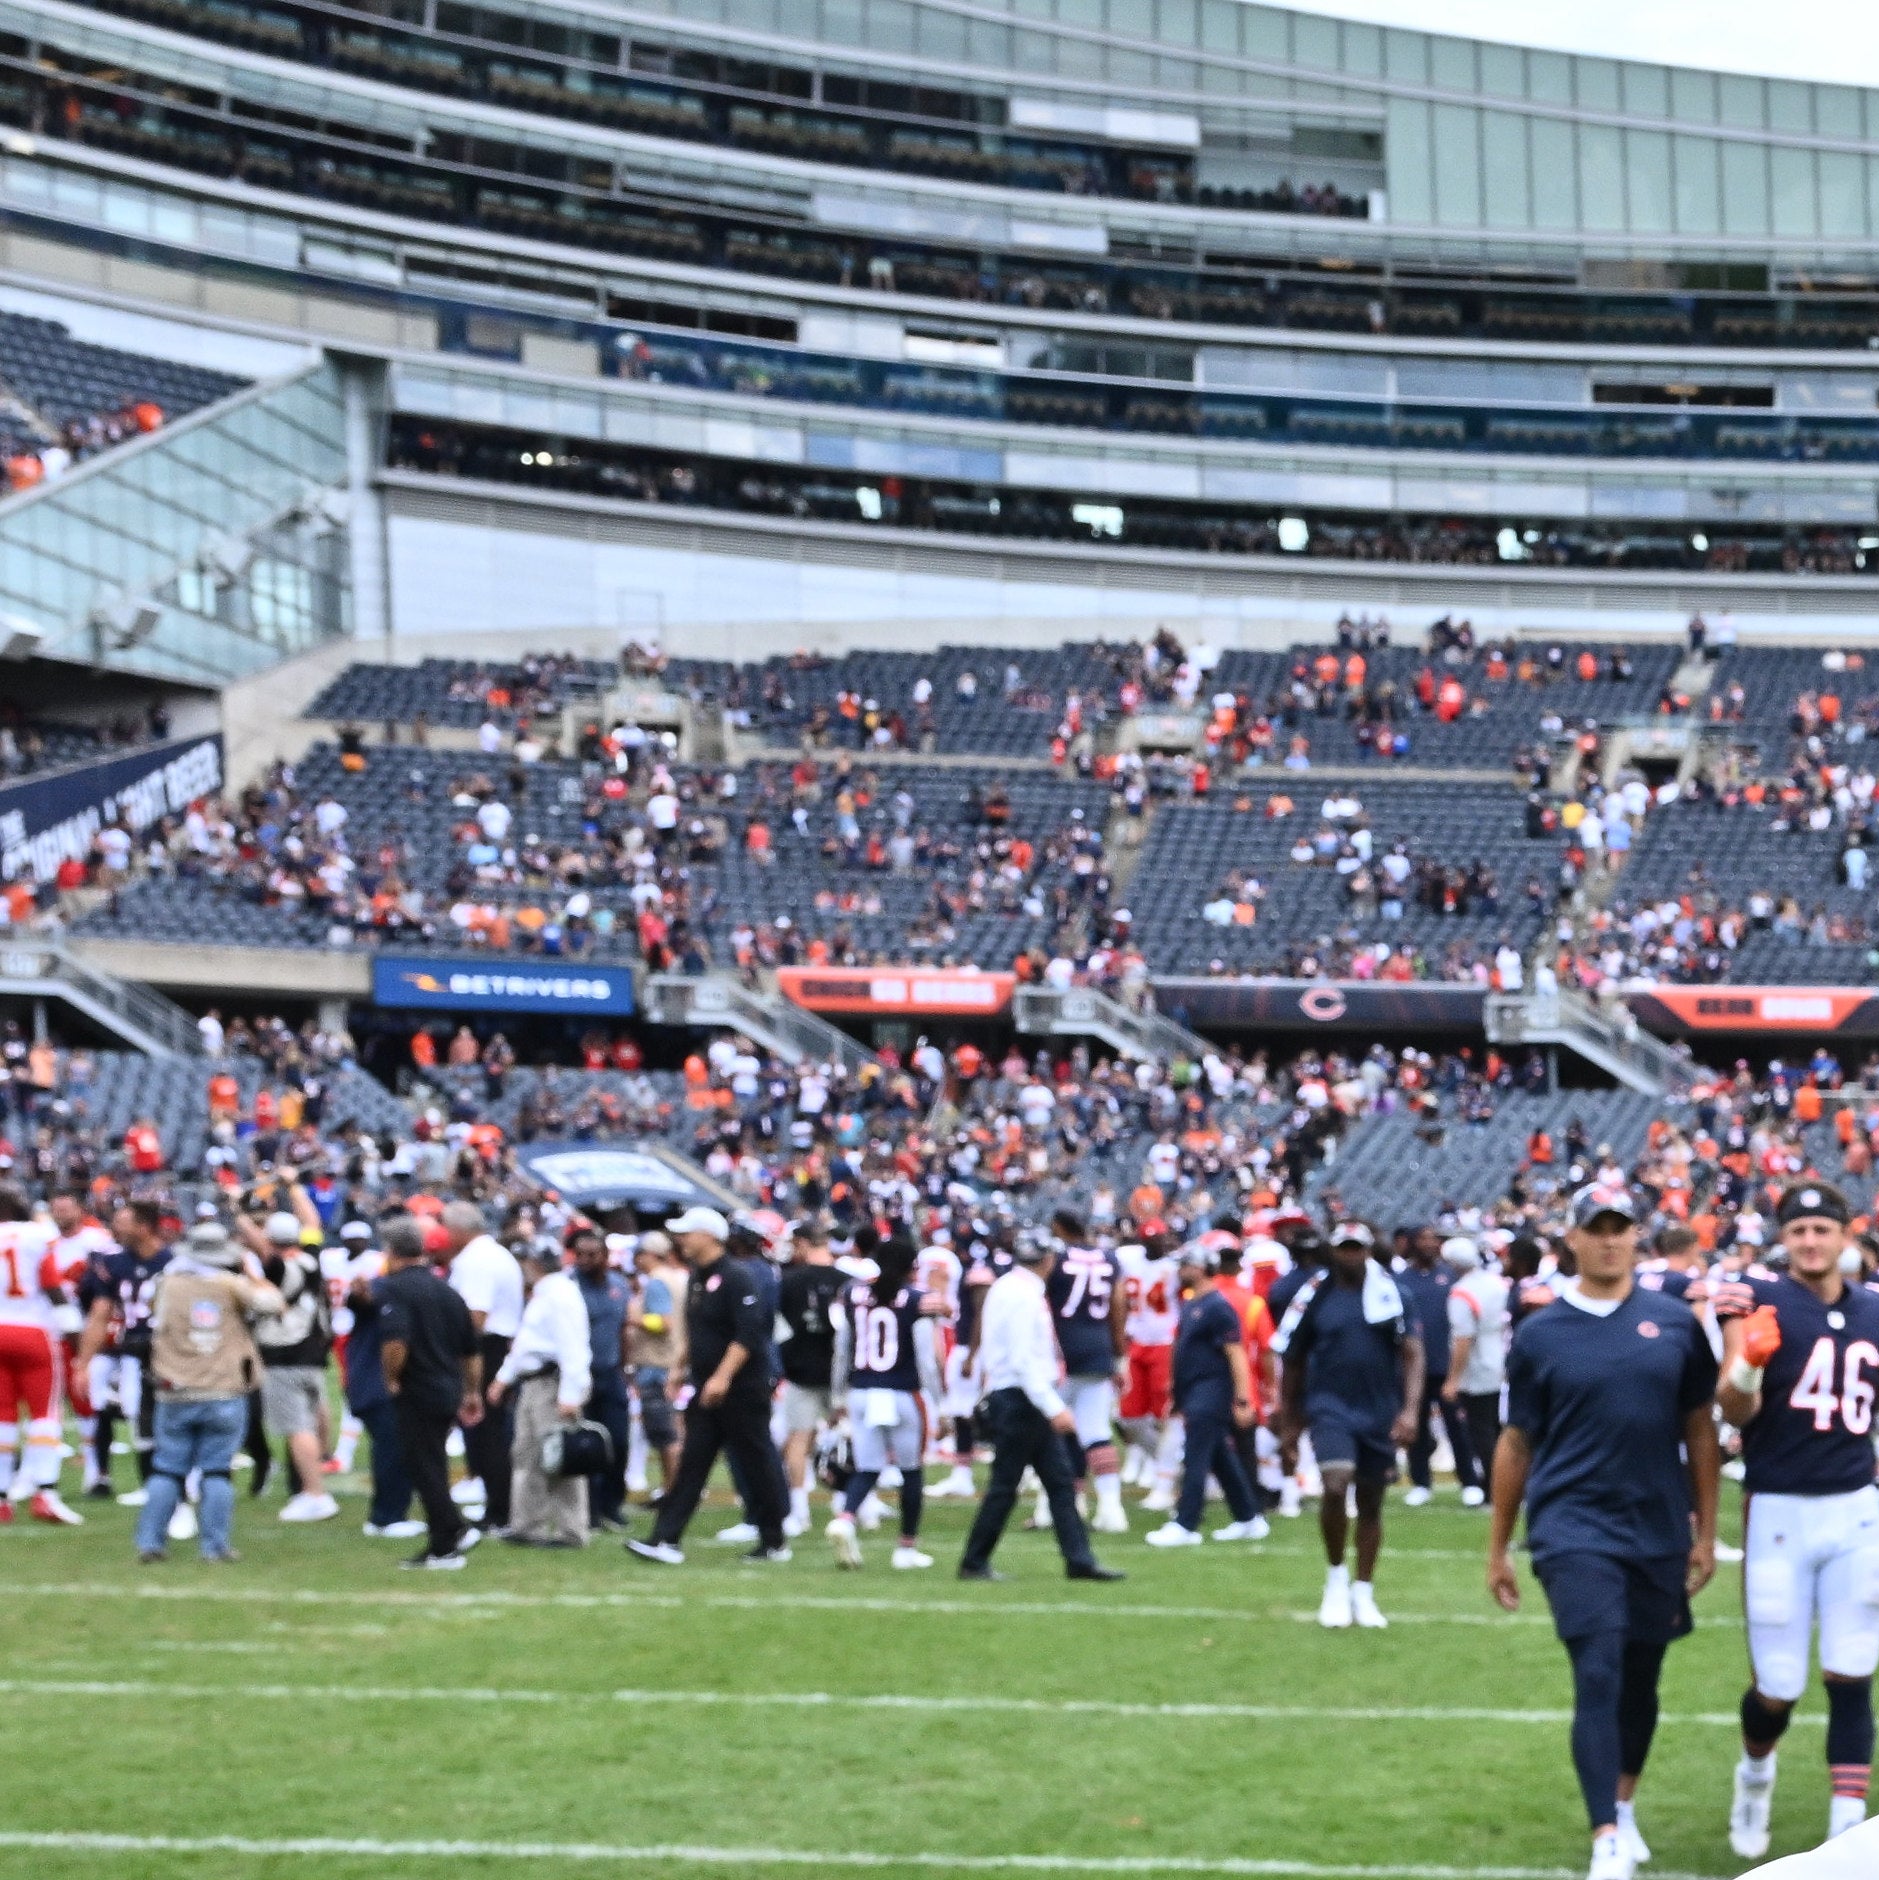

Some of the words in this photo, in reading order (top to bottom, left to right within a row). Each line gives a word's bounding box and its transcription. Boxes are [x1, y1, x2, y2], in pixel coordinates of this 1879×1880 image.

[447, 973, 612, 1000] BETRIVERS
[1061, 1258, 1113, 1319] 75
[854, 1305, 899, 1373] 10
